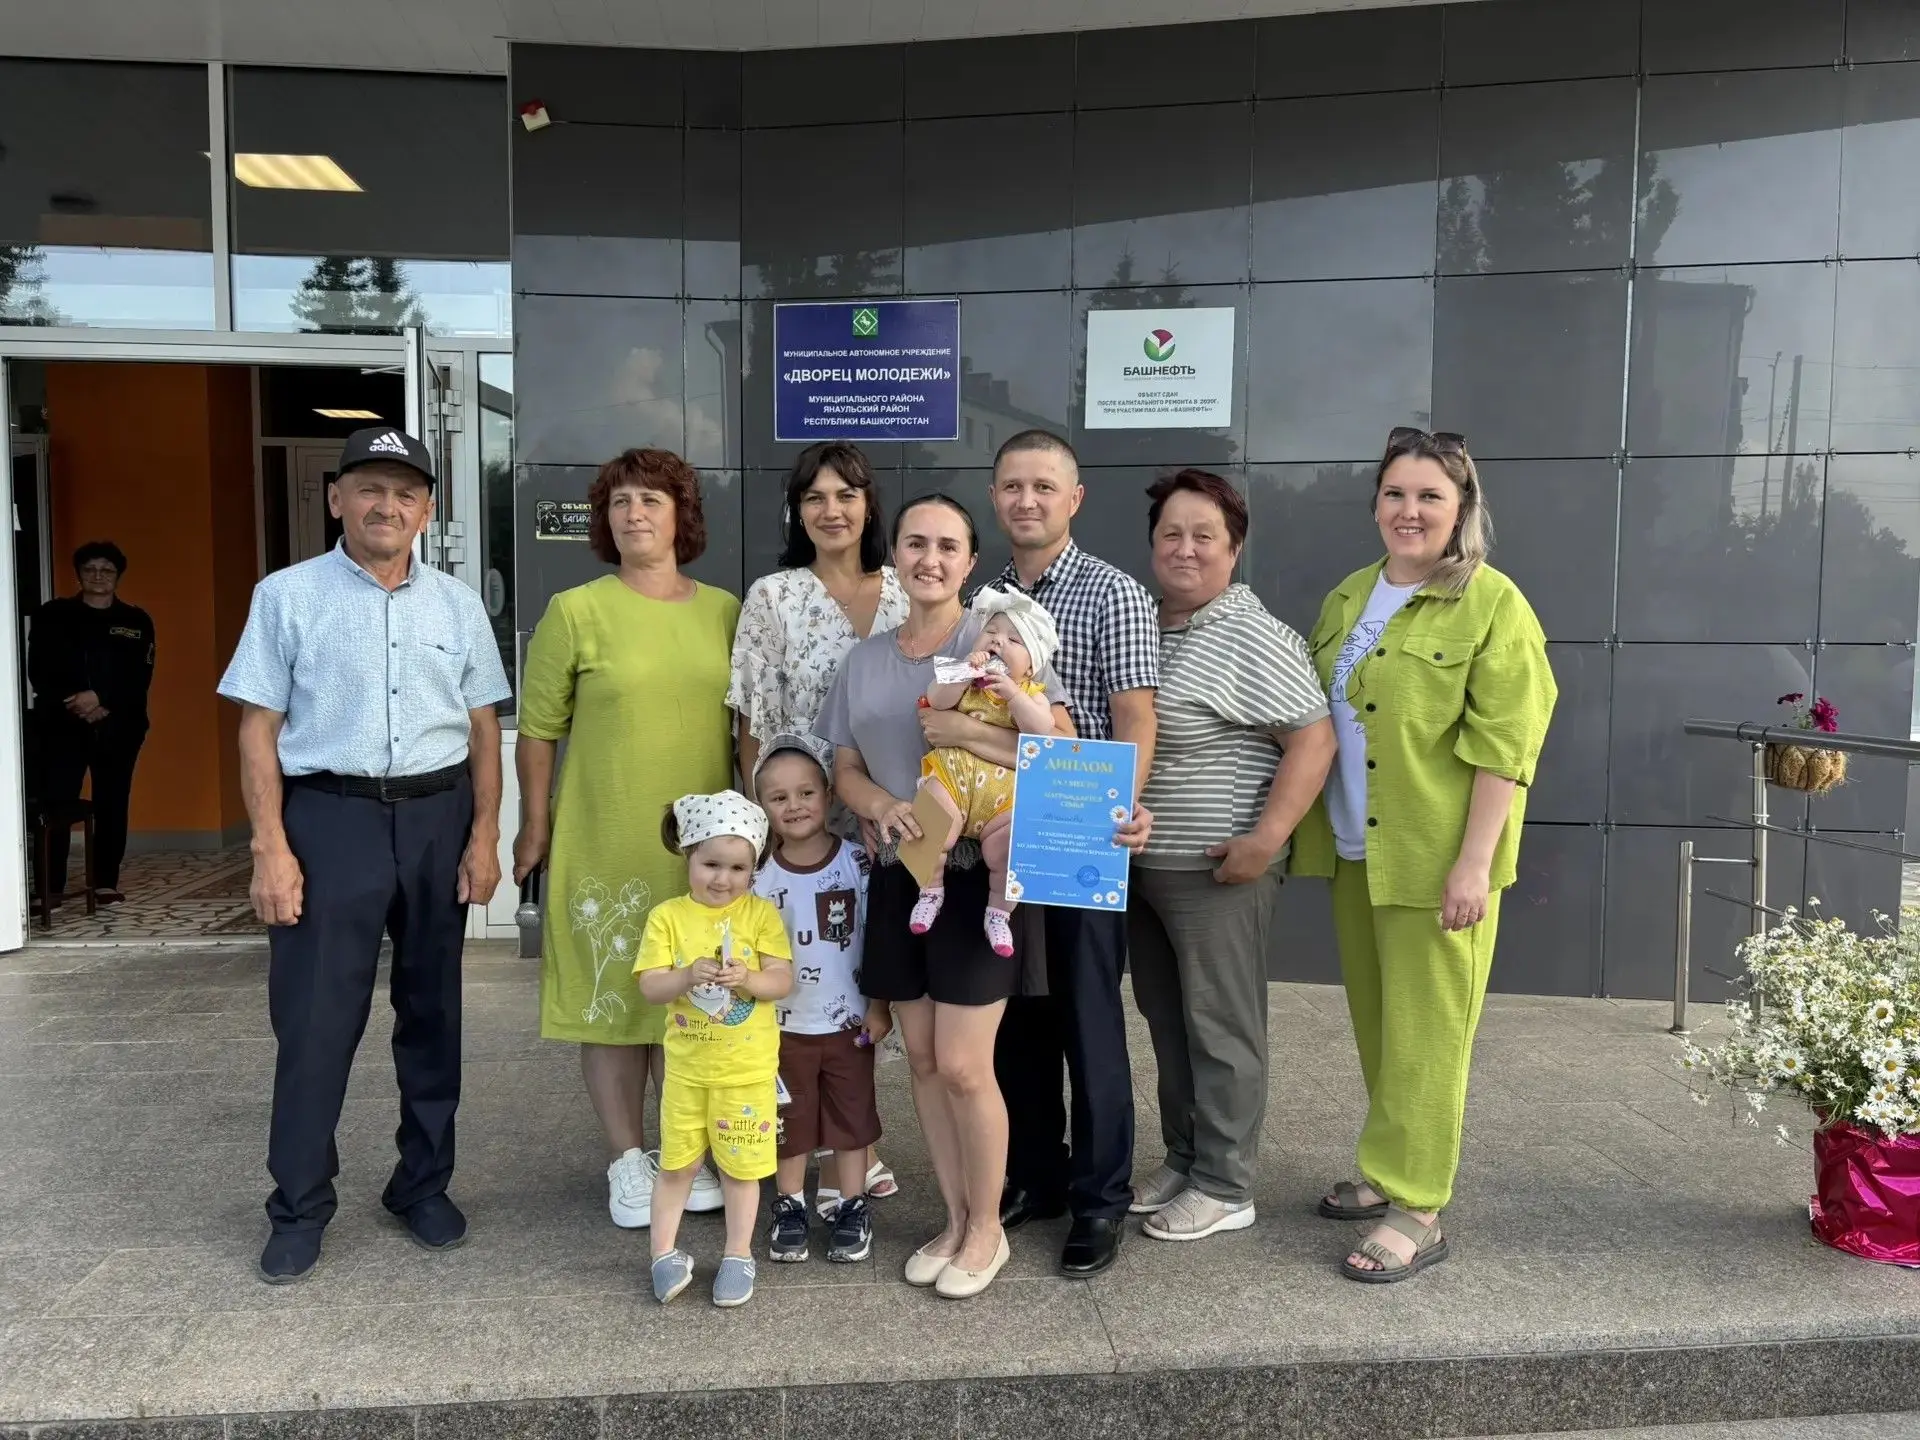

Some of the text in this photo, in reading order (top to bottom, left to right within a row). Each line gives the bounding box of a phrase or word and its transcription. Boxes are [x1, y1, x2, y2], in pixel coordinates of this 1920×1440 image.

[783, 348, 952, 358] МУНИЦИПАЛЬНОЕ АВТОНОМНОЕ УЧРЕЖДЕНИЕ
[783, 367, 951, 383] «ДВОРЕЦ МОЛОДЕЖИ»
[1123, 366, 1196, 376] БАШНЕФТЬ
[808, 393, 925, 404] МУНИЦИПАЛЬНОГО РАЙОНА
[823, 403, 910, 413] ЯНАУЛЬСКИЙ РАЙОН
[804, 417, 929, 426] РЕСПУБЛИКИ БАШКОРТОСТАН
[369, 443, 409, 456] adidas
[798, 930, 813, 946] U
[689, 1019, 709, 1030] little
[733, 1119, 757, 1131] little
